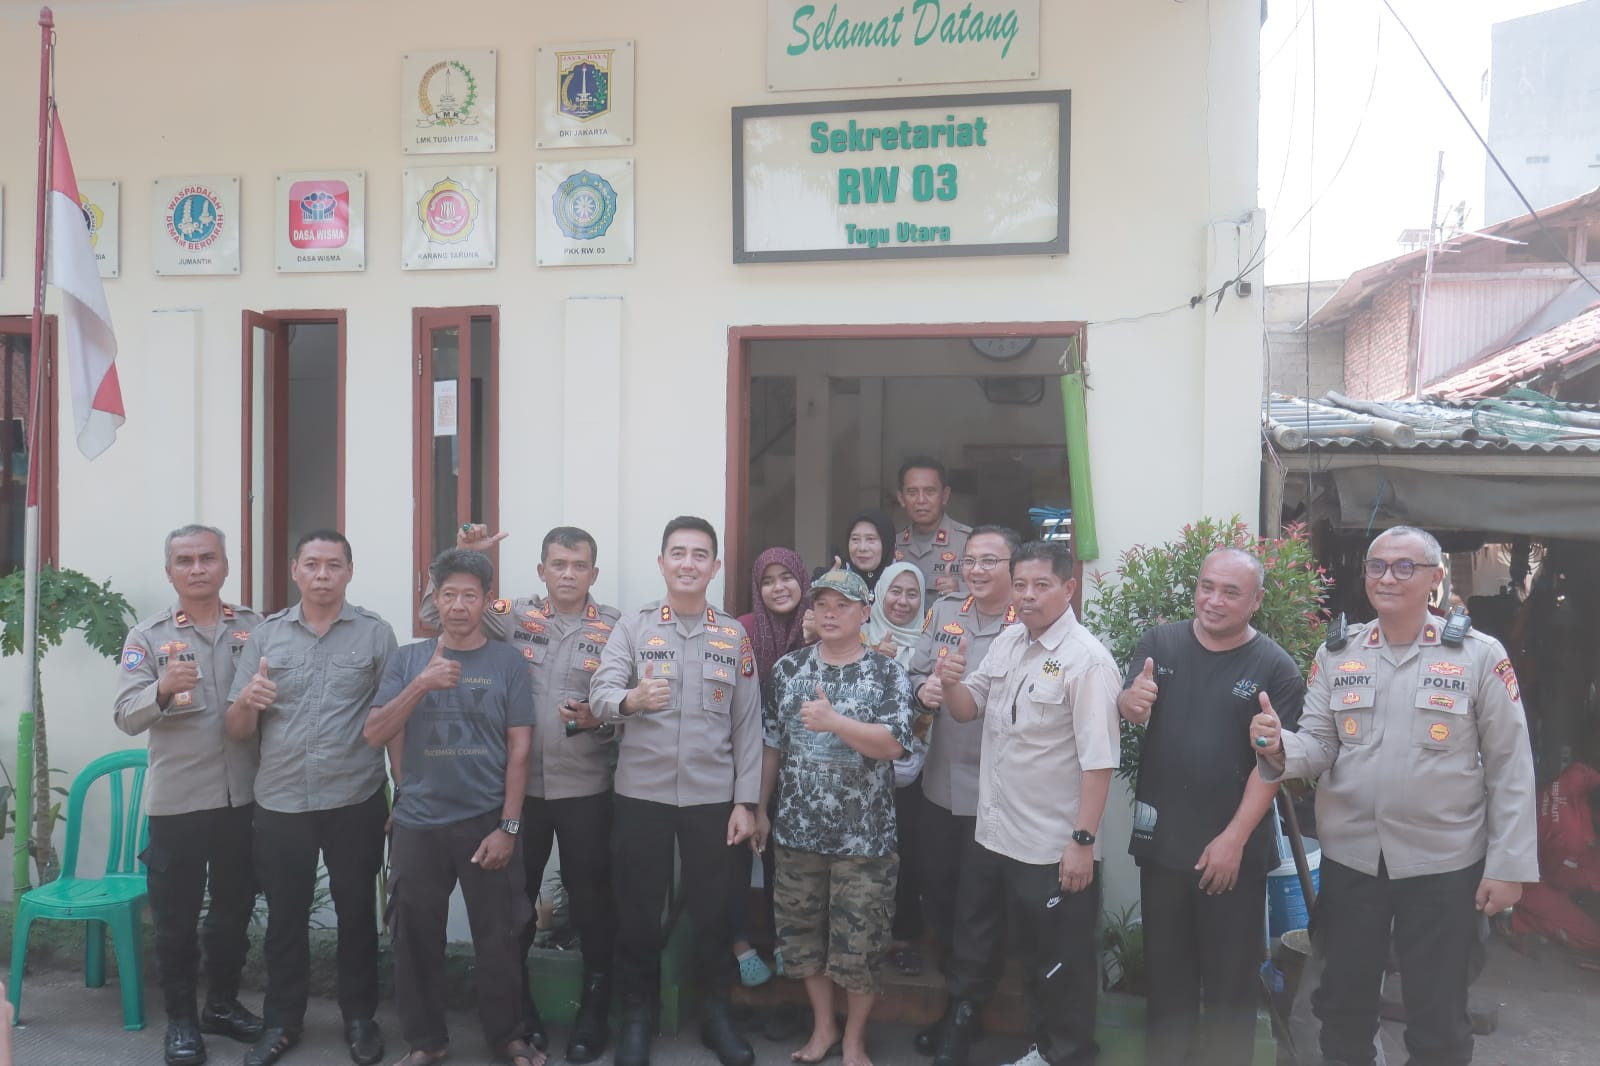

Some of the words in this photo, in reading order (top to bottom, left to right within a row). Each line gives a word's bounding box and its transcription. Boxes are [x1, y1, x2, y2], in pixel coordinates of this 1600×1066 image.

[786, 3, 905, 57] Selamat
[912, 0, 1020, 60] Datang
[435, 111, 460, 119] LMK
[574, 127, 608, 136] JAKARTA
[810, 114, 987, 154] Sekretariat
[416, 136, 432, 144] LMK
[454, 135, 480, 143] UTARA
[838, 166, 900, 205] RW
[912, 162, 958, 203] 03
[168, 186, 222, 211] WASPADALAH
[166, 215, 187, 248] DEMAM
[188, 214, 224, 250] BERDARAH
[293, 229, 315, 241] DASA
[316, 228, 345, 241] WISMA
[845, 223, 890, 249] Tugu
[896, 222, 951, 244] Utara
[417, 252, 448, 260] KARANG
[934, 563, 960, 573] PORI
[578, 642, 601, 655] POL
[639, 650, 676, 660] YONKY
[704, 651, 736, 667] POLRI
[1333, 675, 1371, 688] ANDRY
[1423, 677, 1465, 691] POLRI
